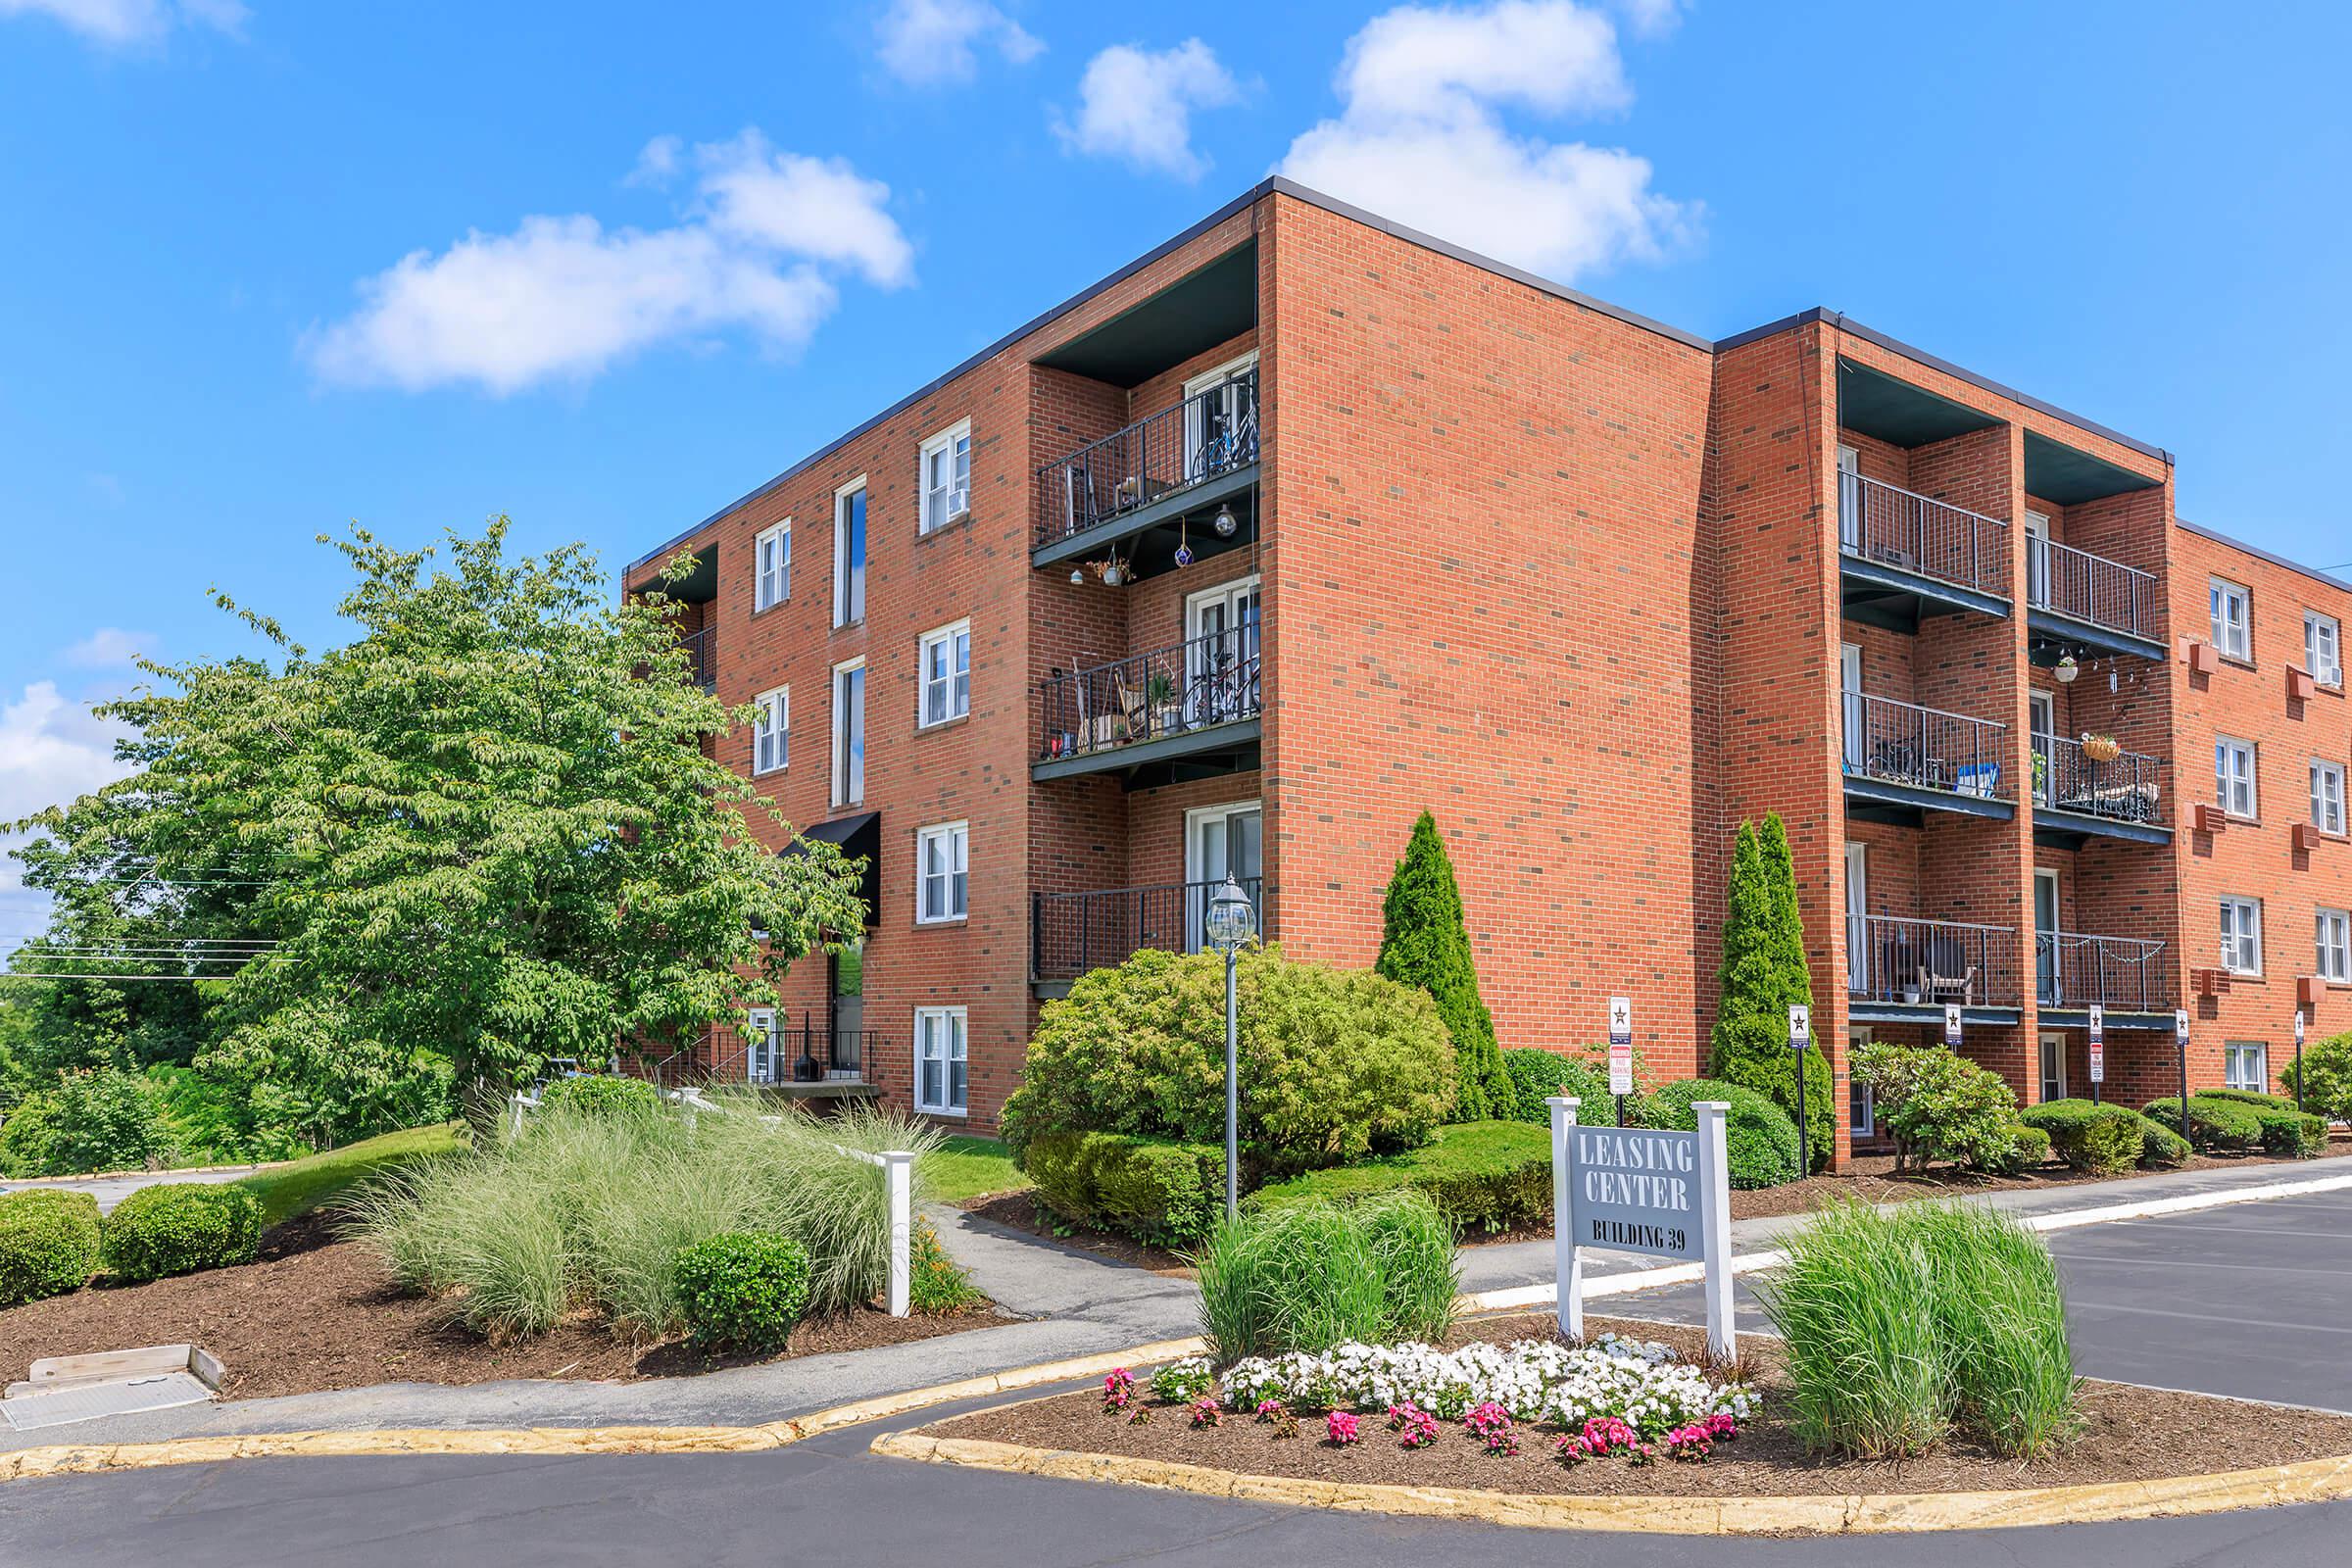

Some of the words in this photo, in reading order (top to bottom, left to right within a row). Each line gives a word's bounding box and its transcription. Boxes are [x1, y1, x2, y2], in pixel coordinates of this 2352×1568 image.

[1579, 1134, 1693, 1173] LEASING
[1586, 1170, 1690, 1211] CENTER
[1592, 1220, 1664, 1249] BUILDING
[1668, 1229, 1686, 1251] 39
